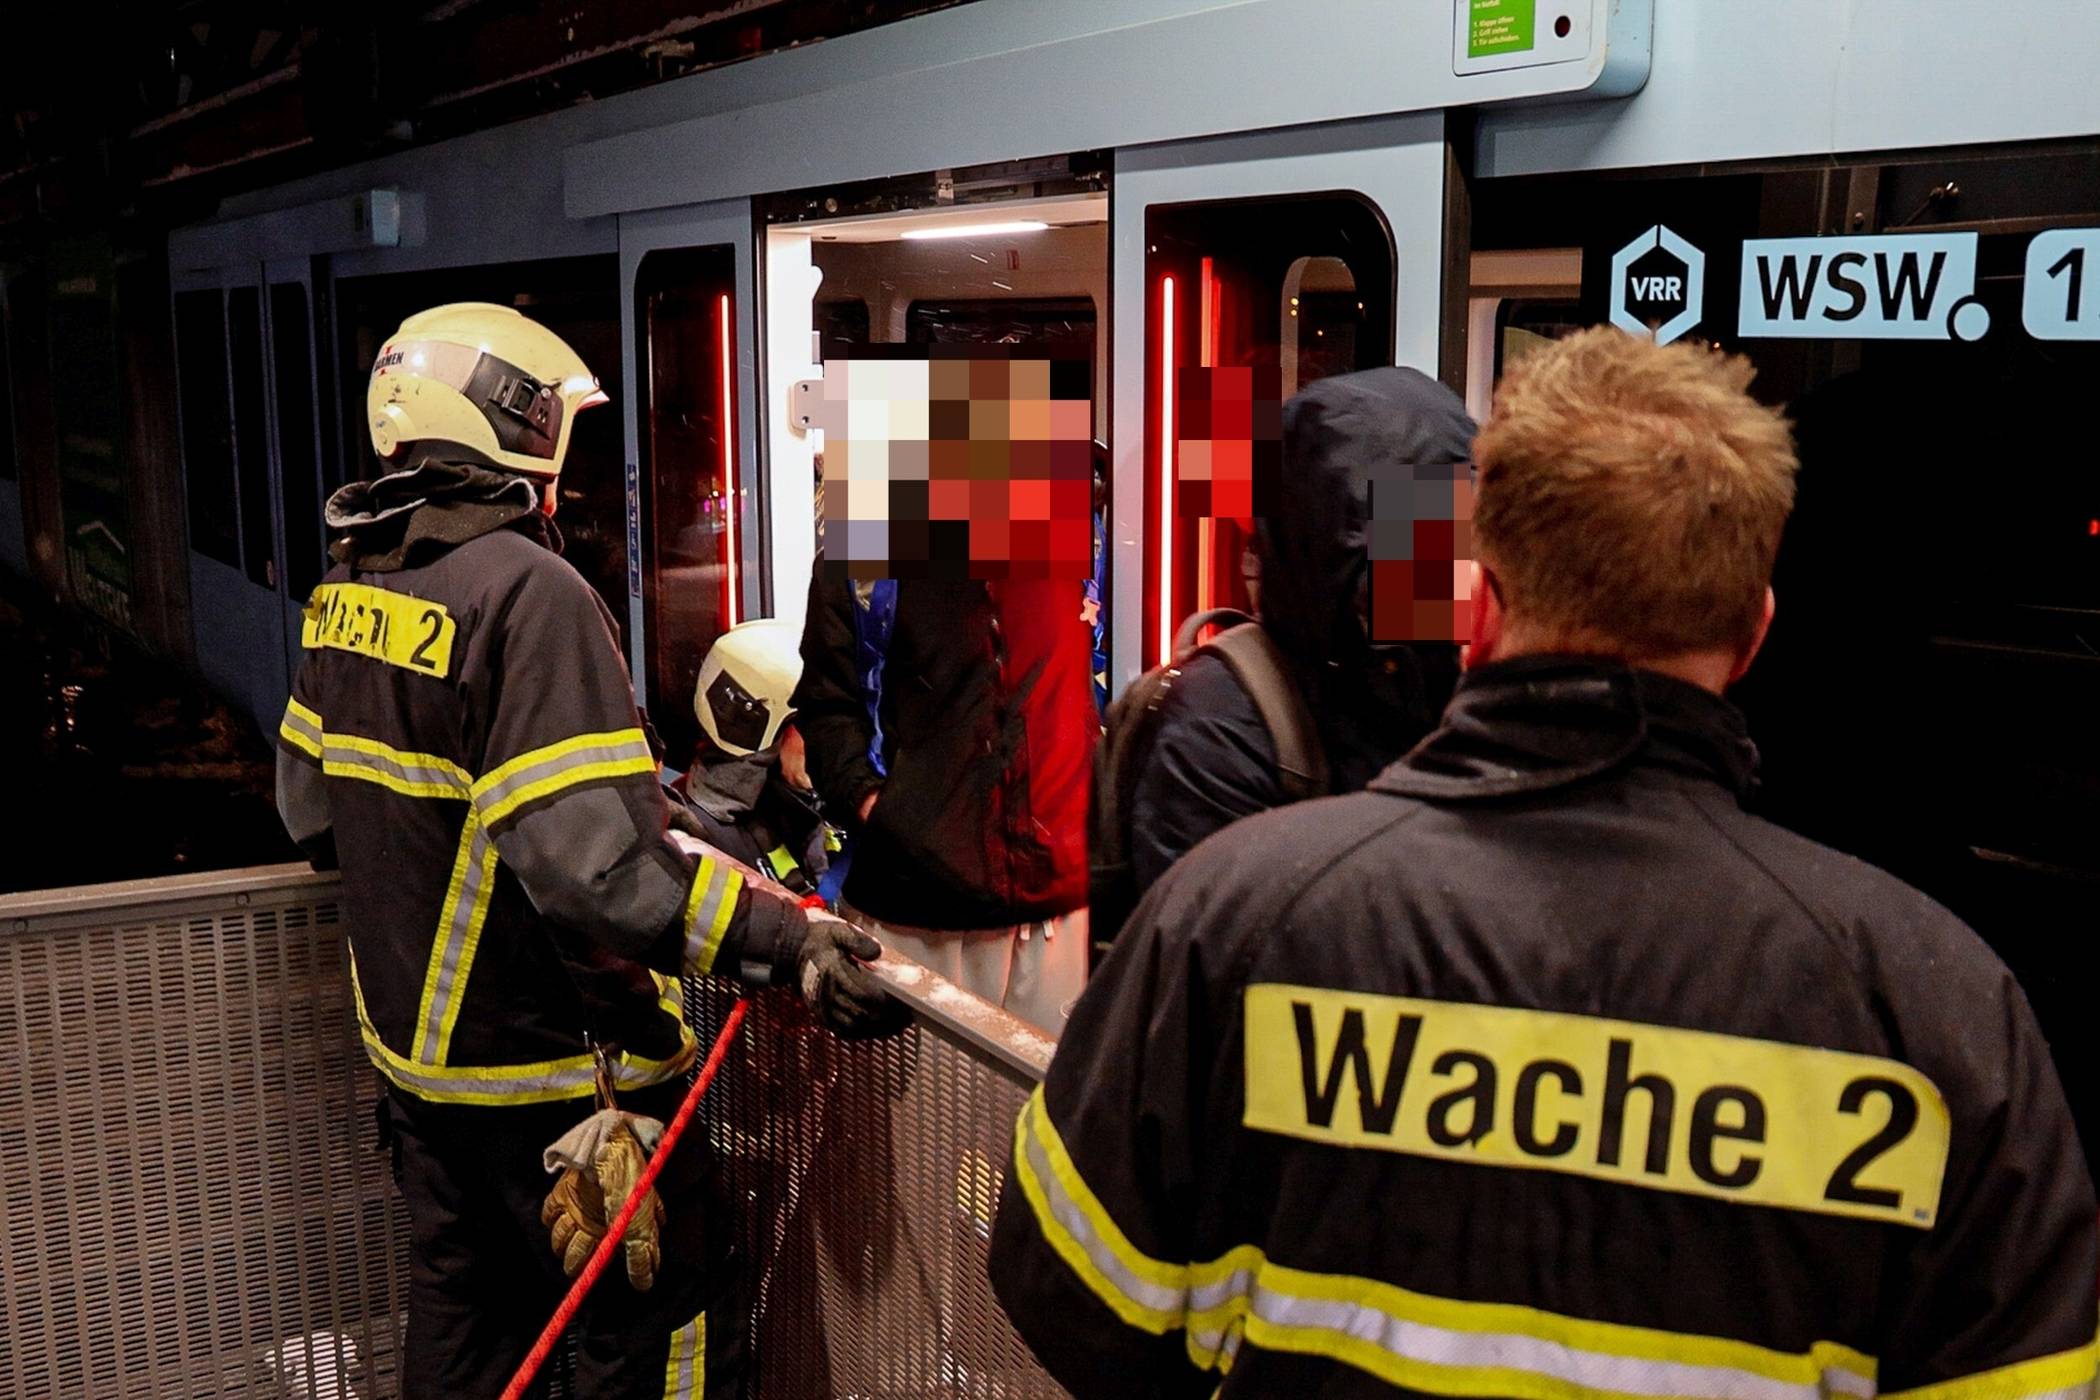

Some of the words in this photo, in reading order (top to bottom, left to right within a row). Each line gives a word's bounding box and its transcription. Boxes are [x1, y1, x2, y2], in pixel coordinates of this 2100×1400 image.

[1631, 276, 1682, 301] VRR
[410, 608, 445, 671] 2
[1292, 1002, 1768, 1189] Wache
[1823, 1075, 1921, 1209] 2
